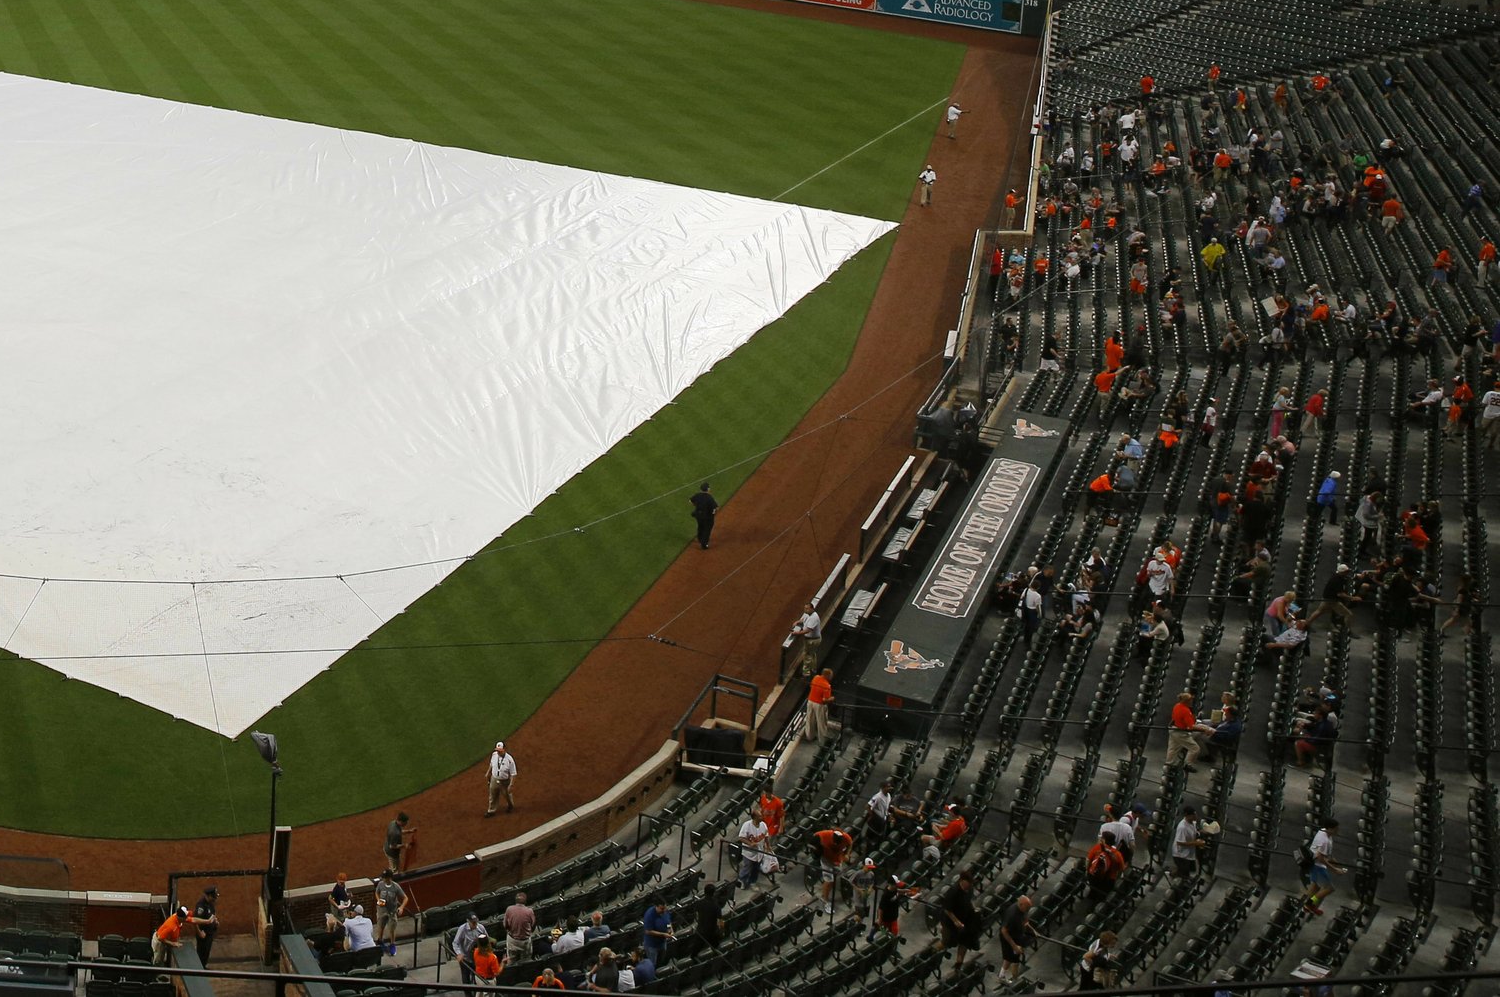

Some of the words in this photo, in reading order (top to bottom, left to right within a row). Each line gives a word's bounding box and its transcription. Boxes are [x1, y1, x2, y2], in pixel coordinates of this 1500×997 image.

[934, 4, 994, 22] RADIOLOGY
[977, 461, 1030, 514] ORIOLES
[960, 513, 1004, 544] THE
[950, 540, 988, 566] OF
[922, 564, 977, 614] HOME
